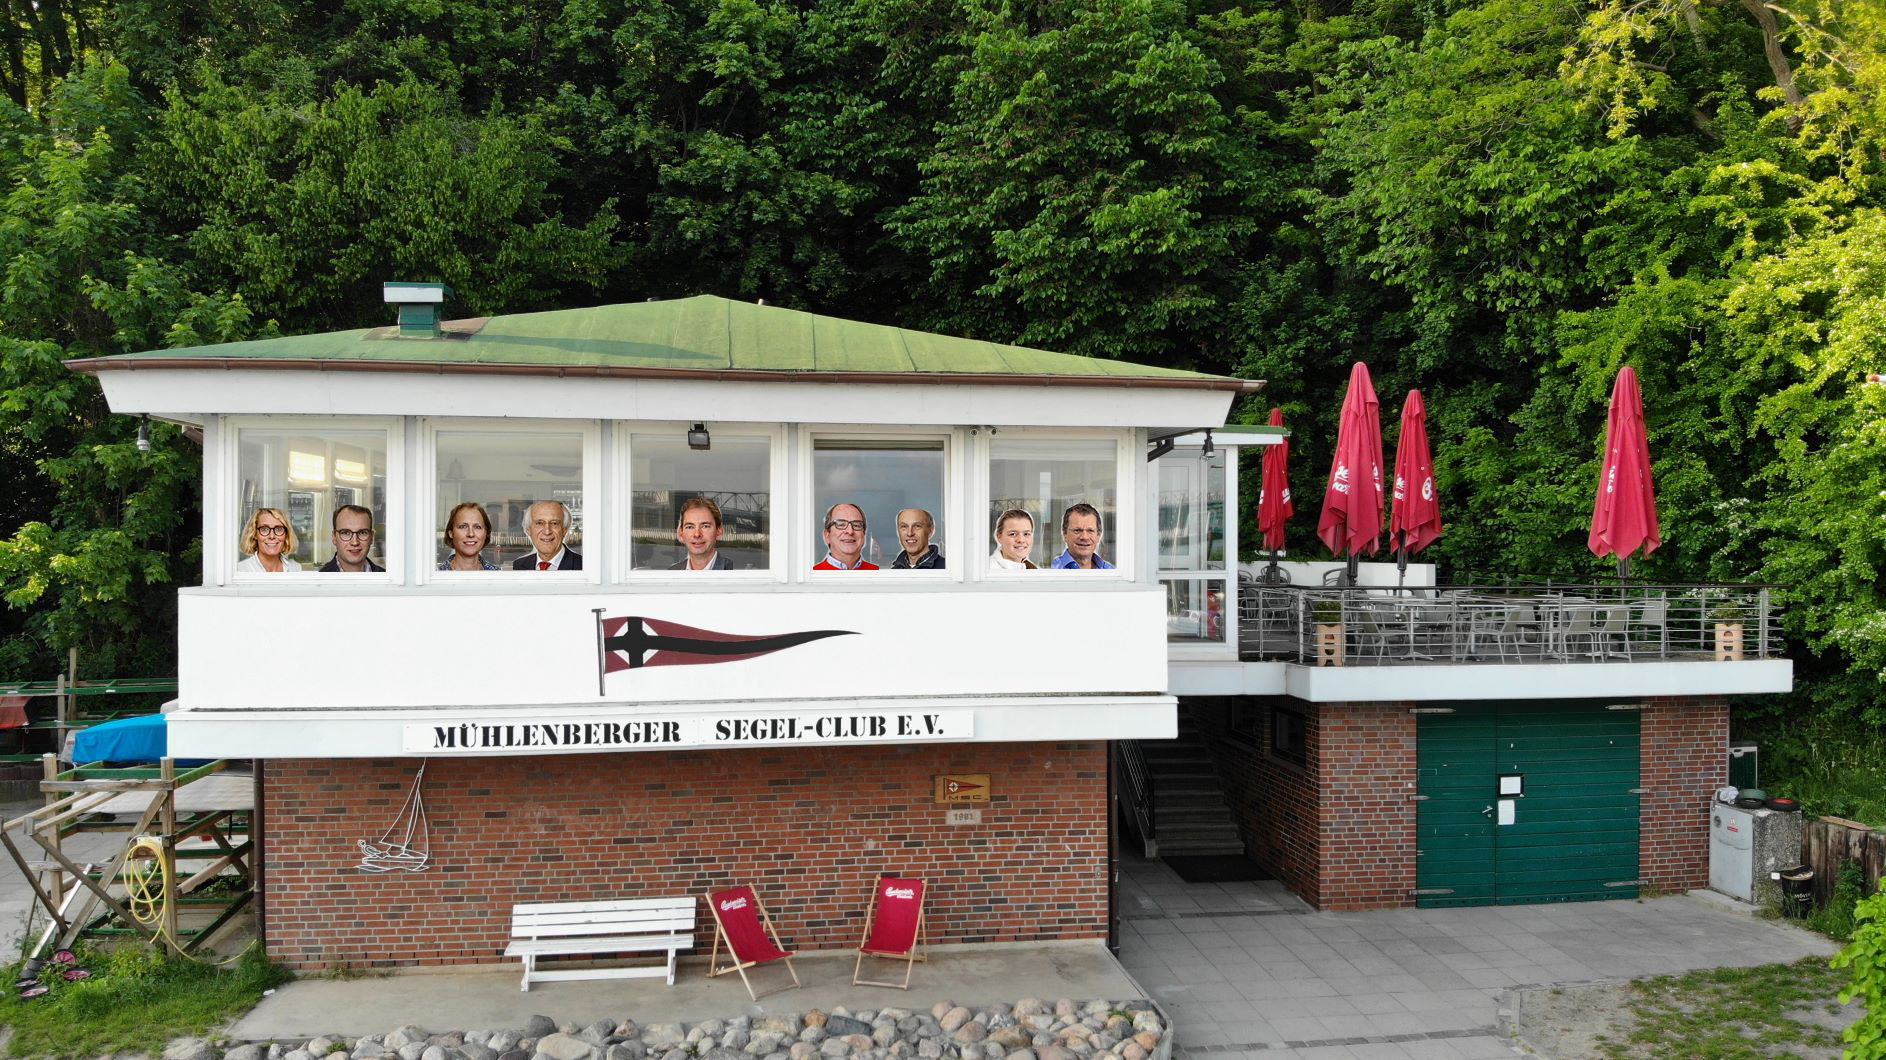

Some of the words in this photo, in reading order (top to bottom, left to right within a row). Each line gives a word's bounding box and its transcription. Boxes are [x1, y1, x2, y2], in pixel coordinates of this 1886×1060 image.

[433, 721, 682, 748] MÜHLENBERGER
[715, 715, 887, 741] SEGEL-CLUB
[897, 714, 944, 736] E.V.
